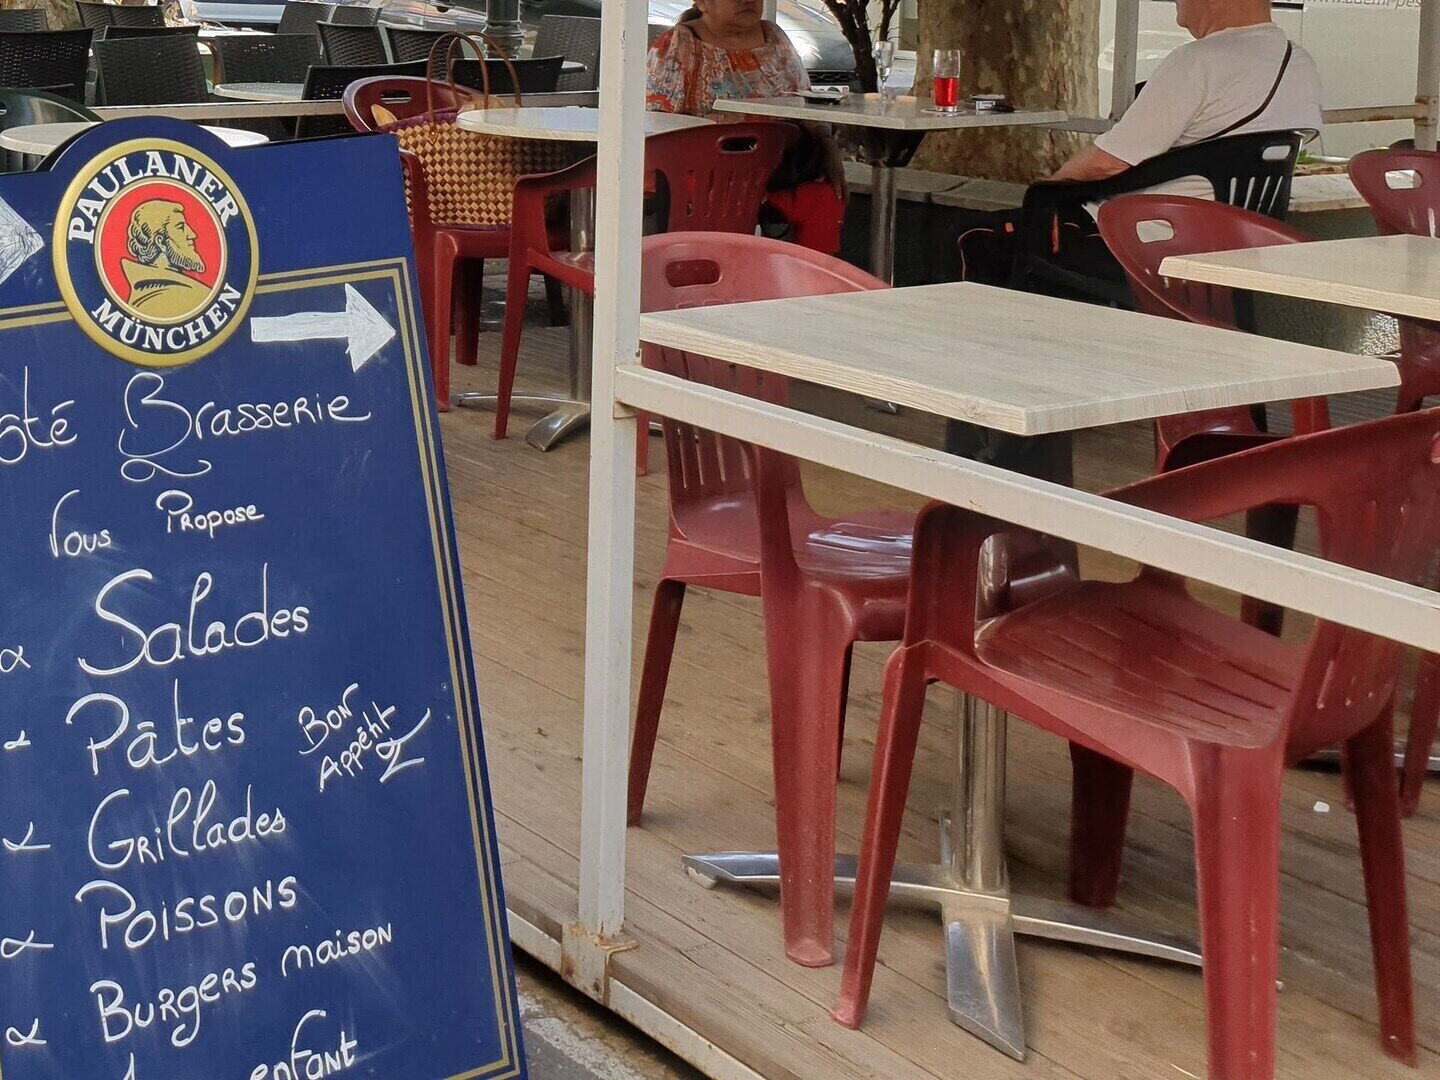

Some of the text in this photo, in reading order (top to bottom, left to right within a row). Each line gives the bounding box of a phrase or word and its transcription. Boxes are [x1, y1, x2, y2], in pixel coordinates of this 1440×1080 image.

[67, 150, 240, 245] PAULANER
[90, 280, 243, 351] MÜNCHEN
[118, 371, 372, 460] Brasserie
[155, 489, 266, 536] Propose
[77, 562, 310, 676] Salades
[65, 678, 246, 776] Pâtes
[88, 779, 287, 869] Grillades
[75, 876, 298, 950] Poissons
[89, 922, 393, 1048] Burgers maison
